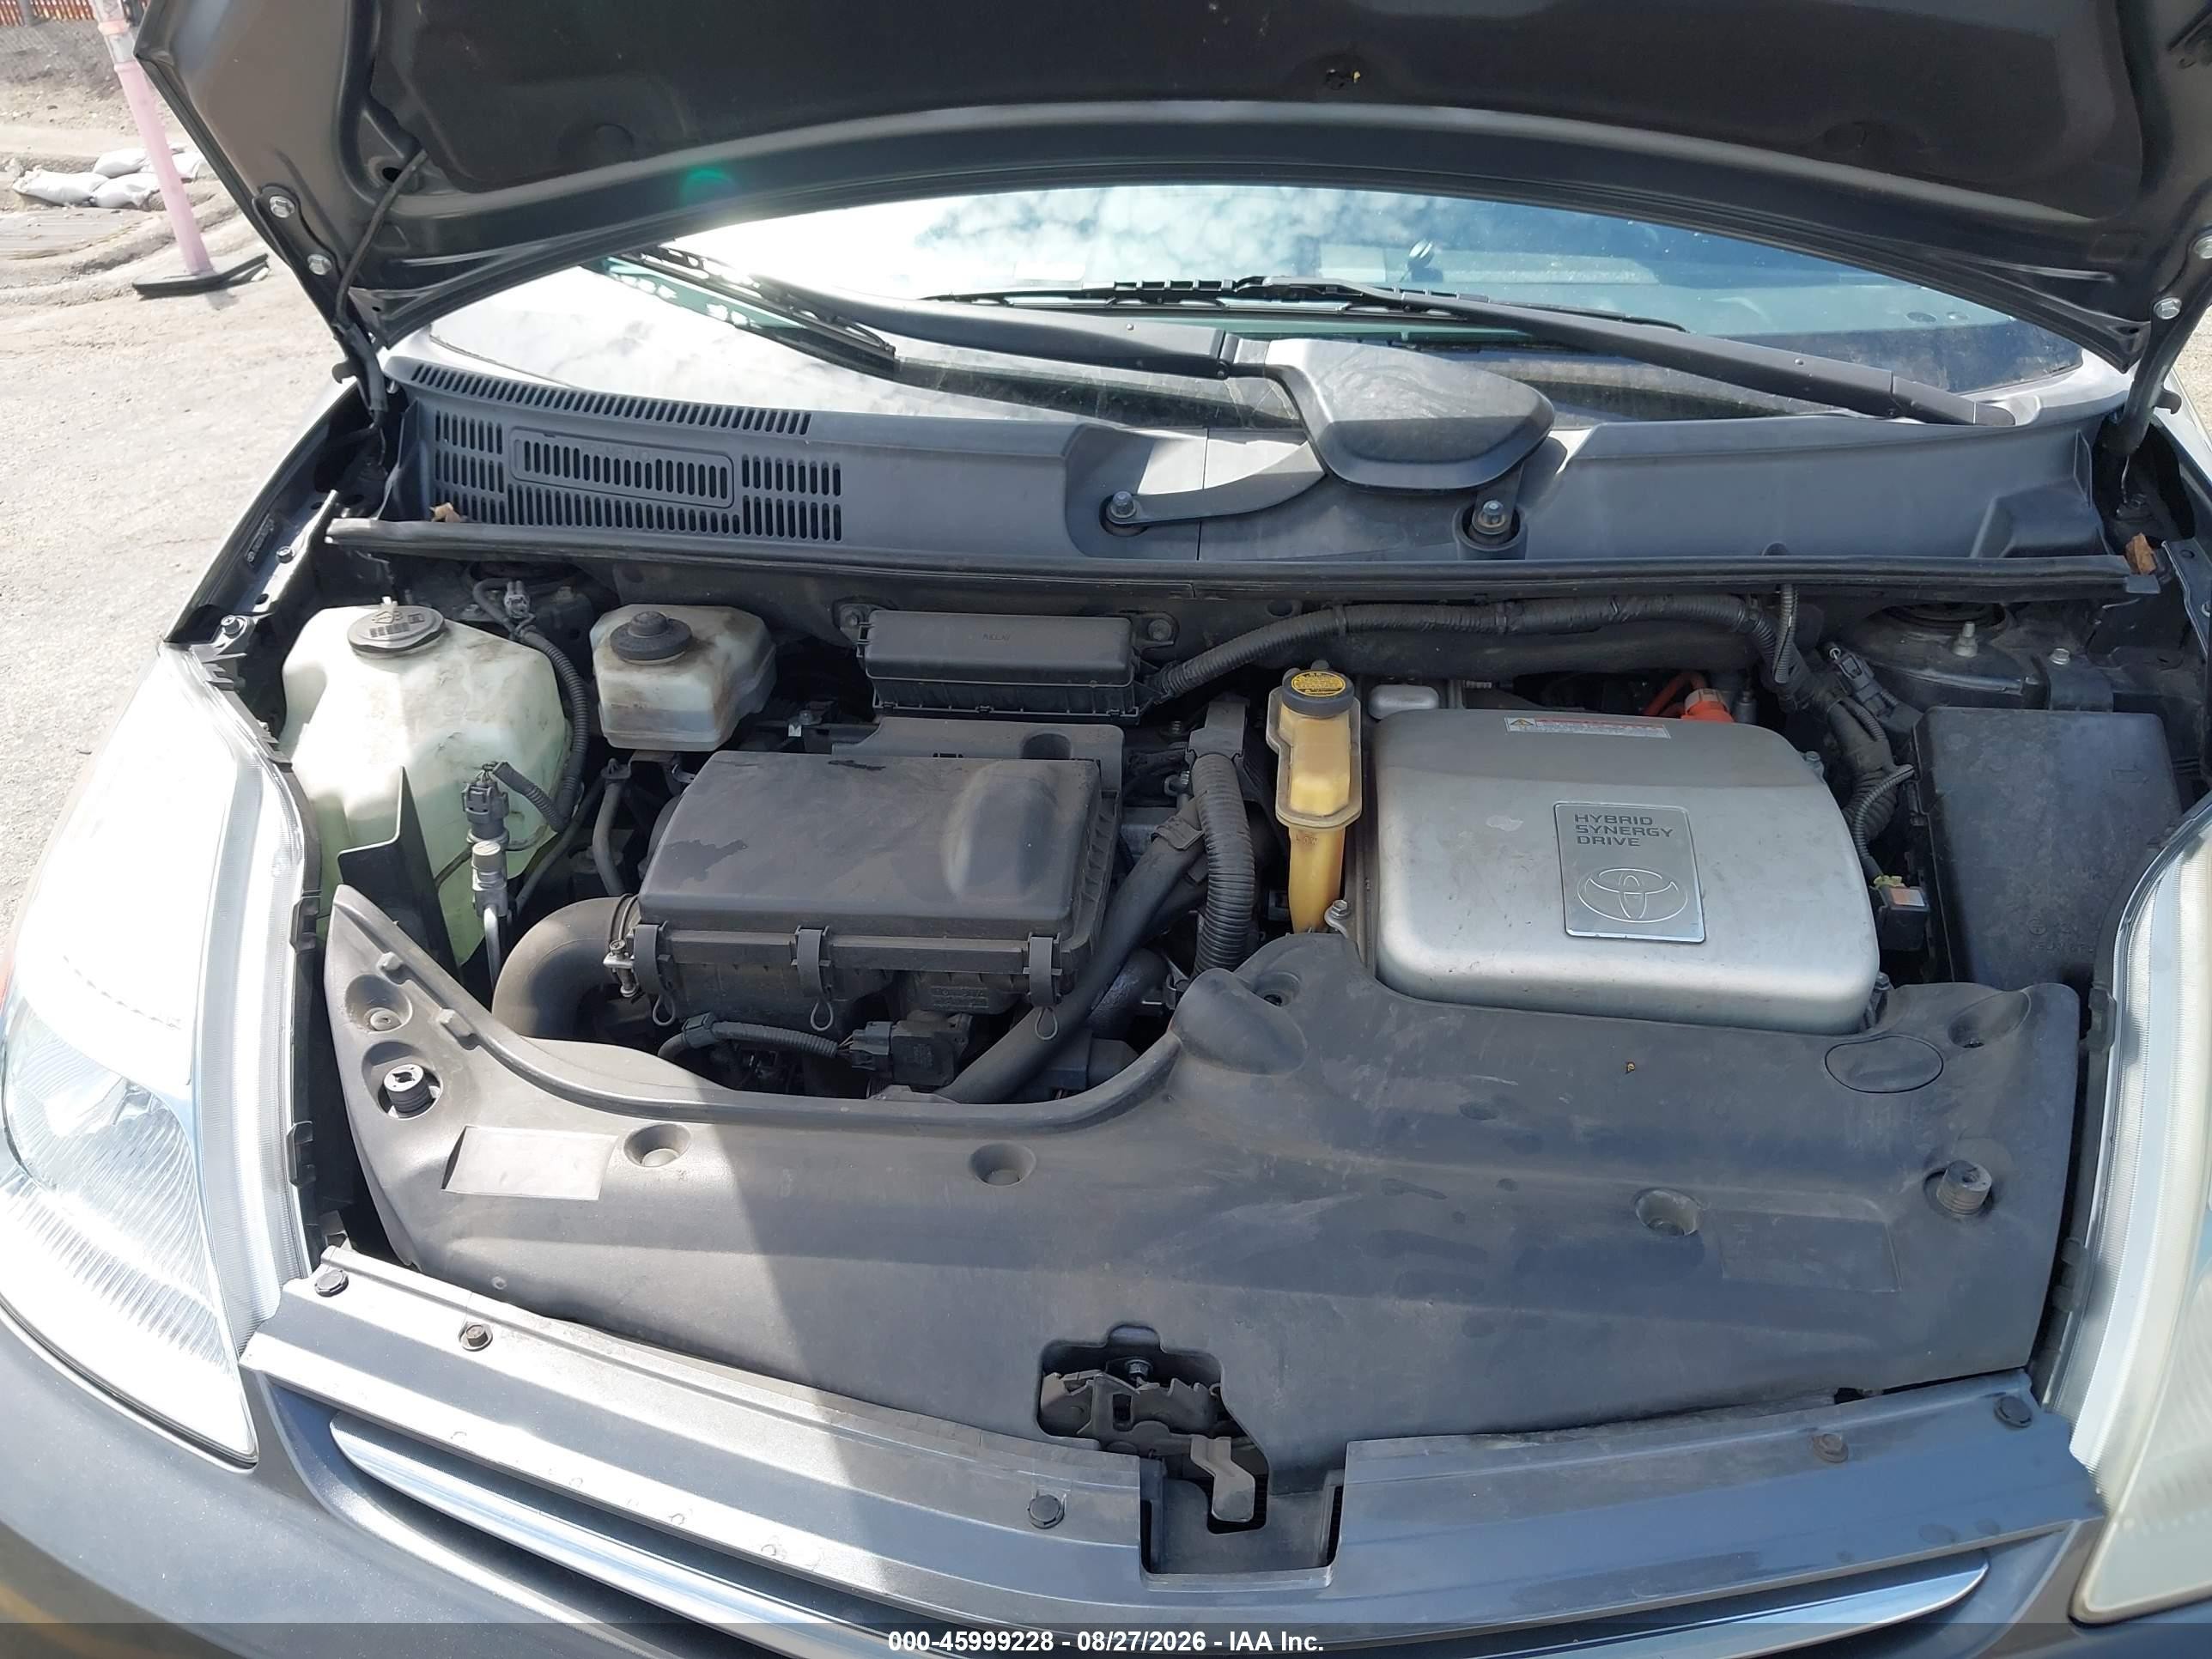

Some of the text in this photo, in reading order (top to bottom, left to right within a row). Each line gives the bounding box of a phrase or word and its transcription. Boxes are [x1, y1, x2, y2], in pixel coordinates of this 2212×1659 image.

[1574, 814, 1653, 825] HYBRID
[1576, 824, 1674, 837] SYNERGY
[1577, 836, 1640, 847] DRIVE
